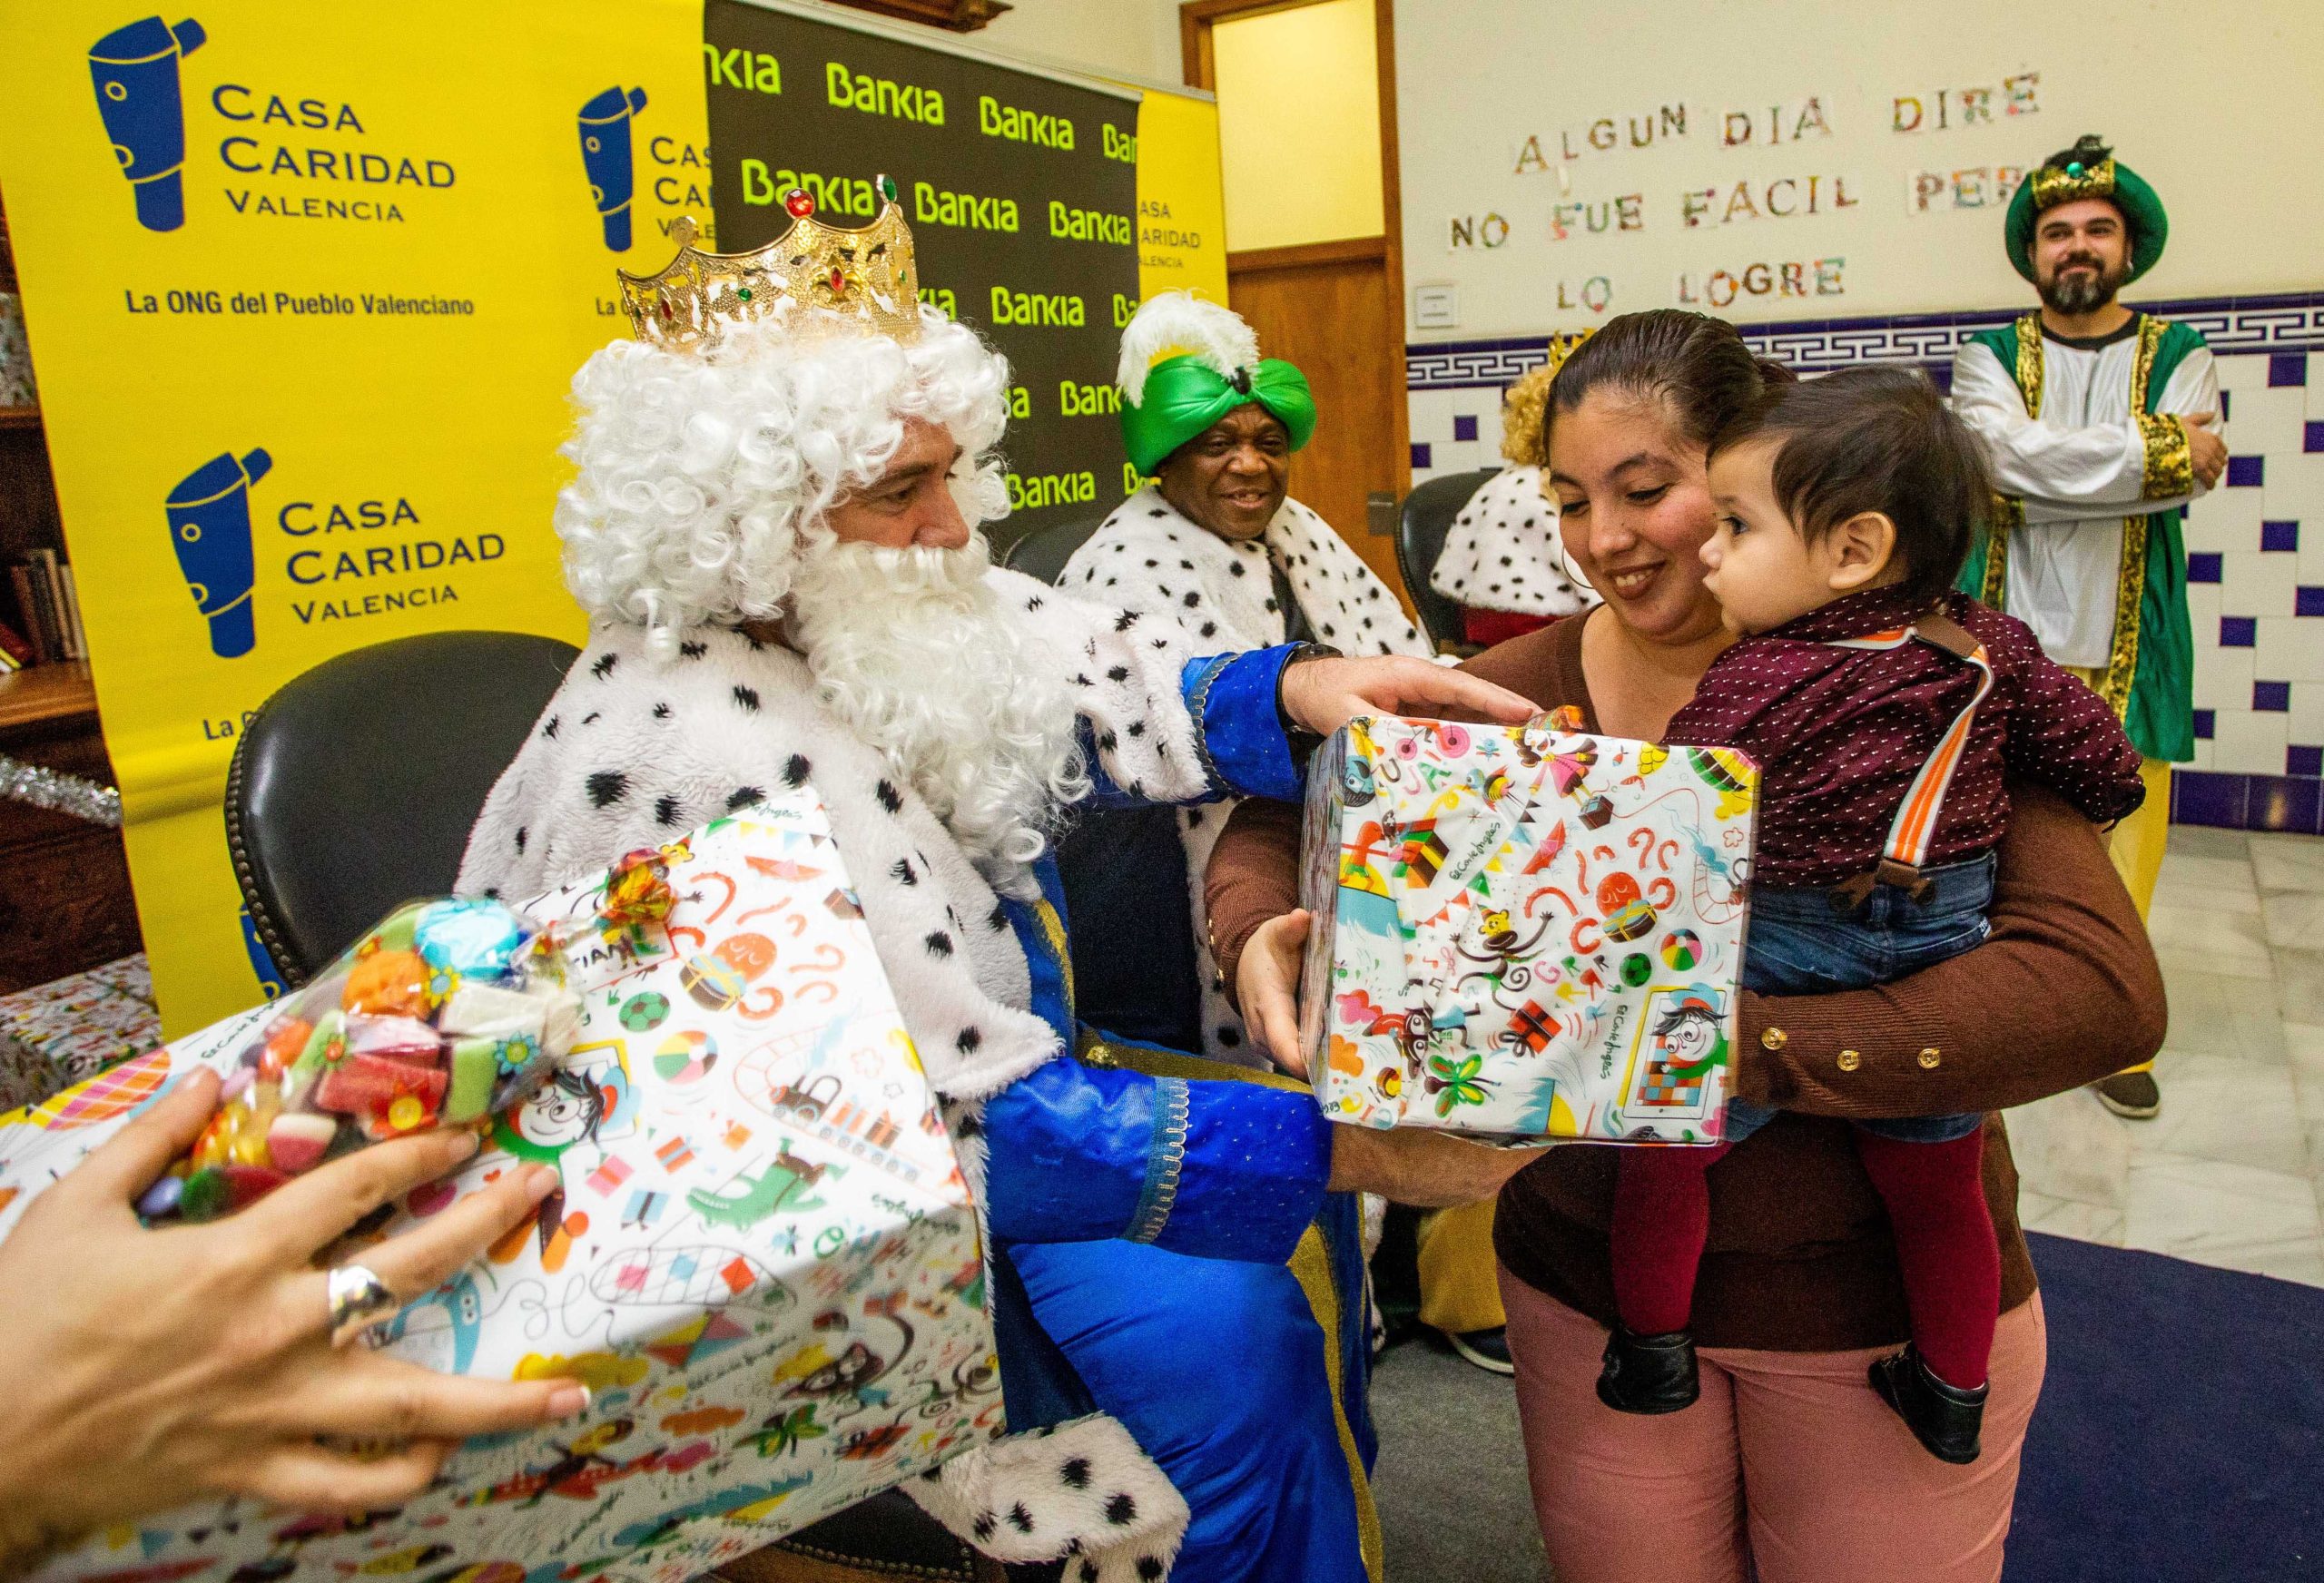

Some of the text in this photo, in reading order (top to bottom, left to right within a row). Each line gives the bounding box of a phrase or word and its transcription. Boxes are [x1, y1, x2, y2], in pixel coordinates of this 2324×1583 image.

[703, 43, 782, 94] nkia
[212, 84, 366, 134] CASA
[825, 62, 944, 125] Bankia
[979, 95, 1075, 151] Bankia
[1513, 102, 1688, 175] ALGUN
[1724, 96, 1833, 147] DIA
[220, 136, 455, 189] CARIDAD
[224, 188, 405, 222] VALENCIA
[741, 158, 875, 216] Bankia
[914, 182, 1019, 232] Bankia
[1452, 166, 2025, 249] NO FUE FACIL PER
[1049, 201, 1131, 245] Bankia
[1139, 201, 1171, 219] ASA
[1140, 228, 1201, 248] ARIDAD
[124, 289, 475, 316] La ONG del Pueblo Valenciano
[596, 297, 615, 316] La
[1557, 256, 1847, 313] LO LOGRE
[990, 287, 1086, 327] Bankia
[1059, 380, 1121, 416] Bank
[1007, 471, 1096, 510] Bankia
[279, 497, 420, 536] CASA
[287, 534, 505, 585] CARIDAD
[291, 585, 459, 624] VALENCIA
[202, 719, 234, 741] La
